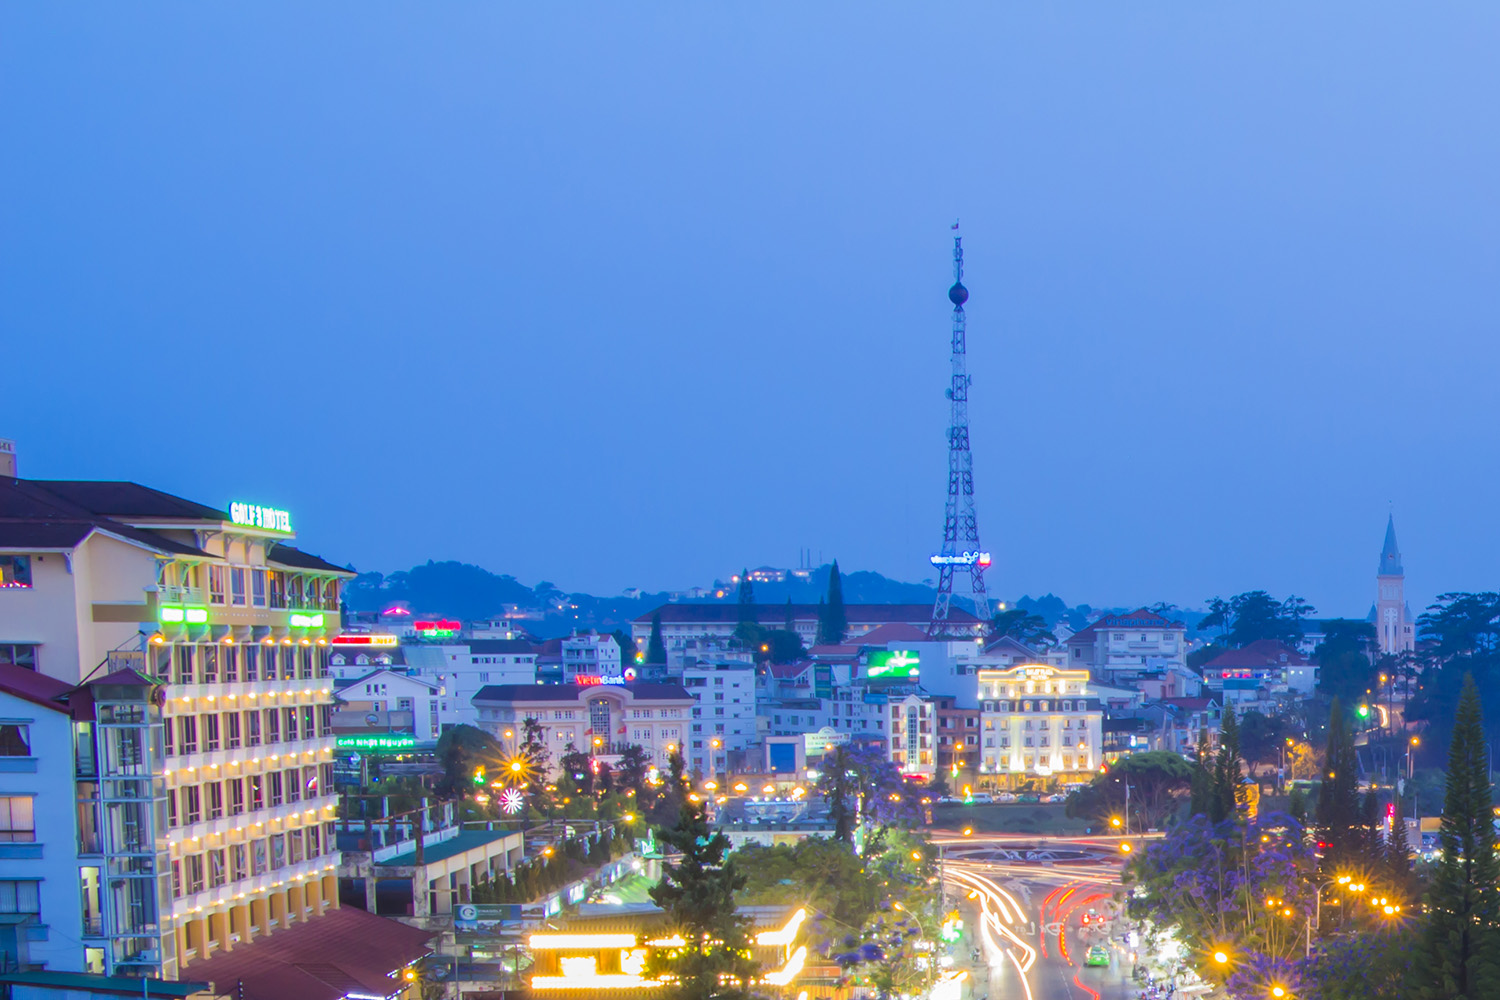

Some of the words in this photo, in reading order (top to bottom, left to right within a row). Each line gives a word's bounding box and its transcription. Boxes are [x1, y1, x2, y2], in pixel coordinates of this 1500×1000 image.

[230, 501, 255, 526] GOLF
[255, 505, 263, 527] 3
[262, 507, 292, 533] HOTEL
